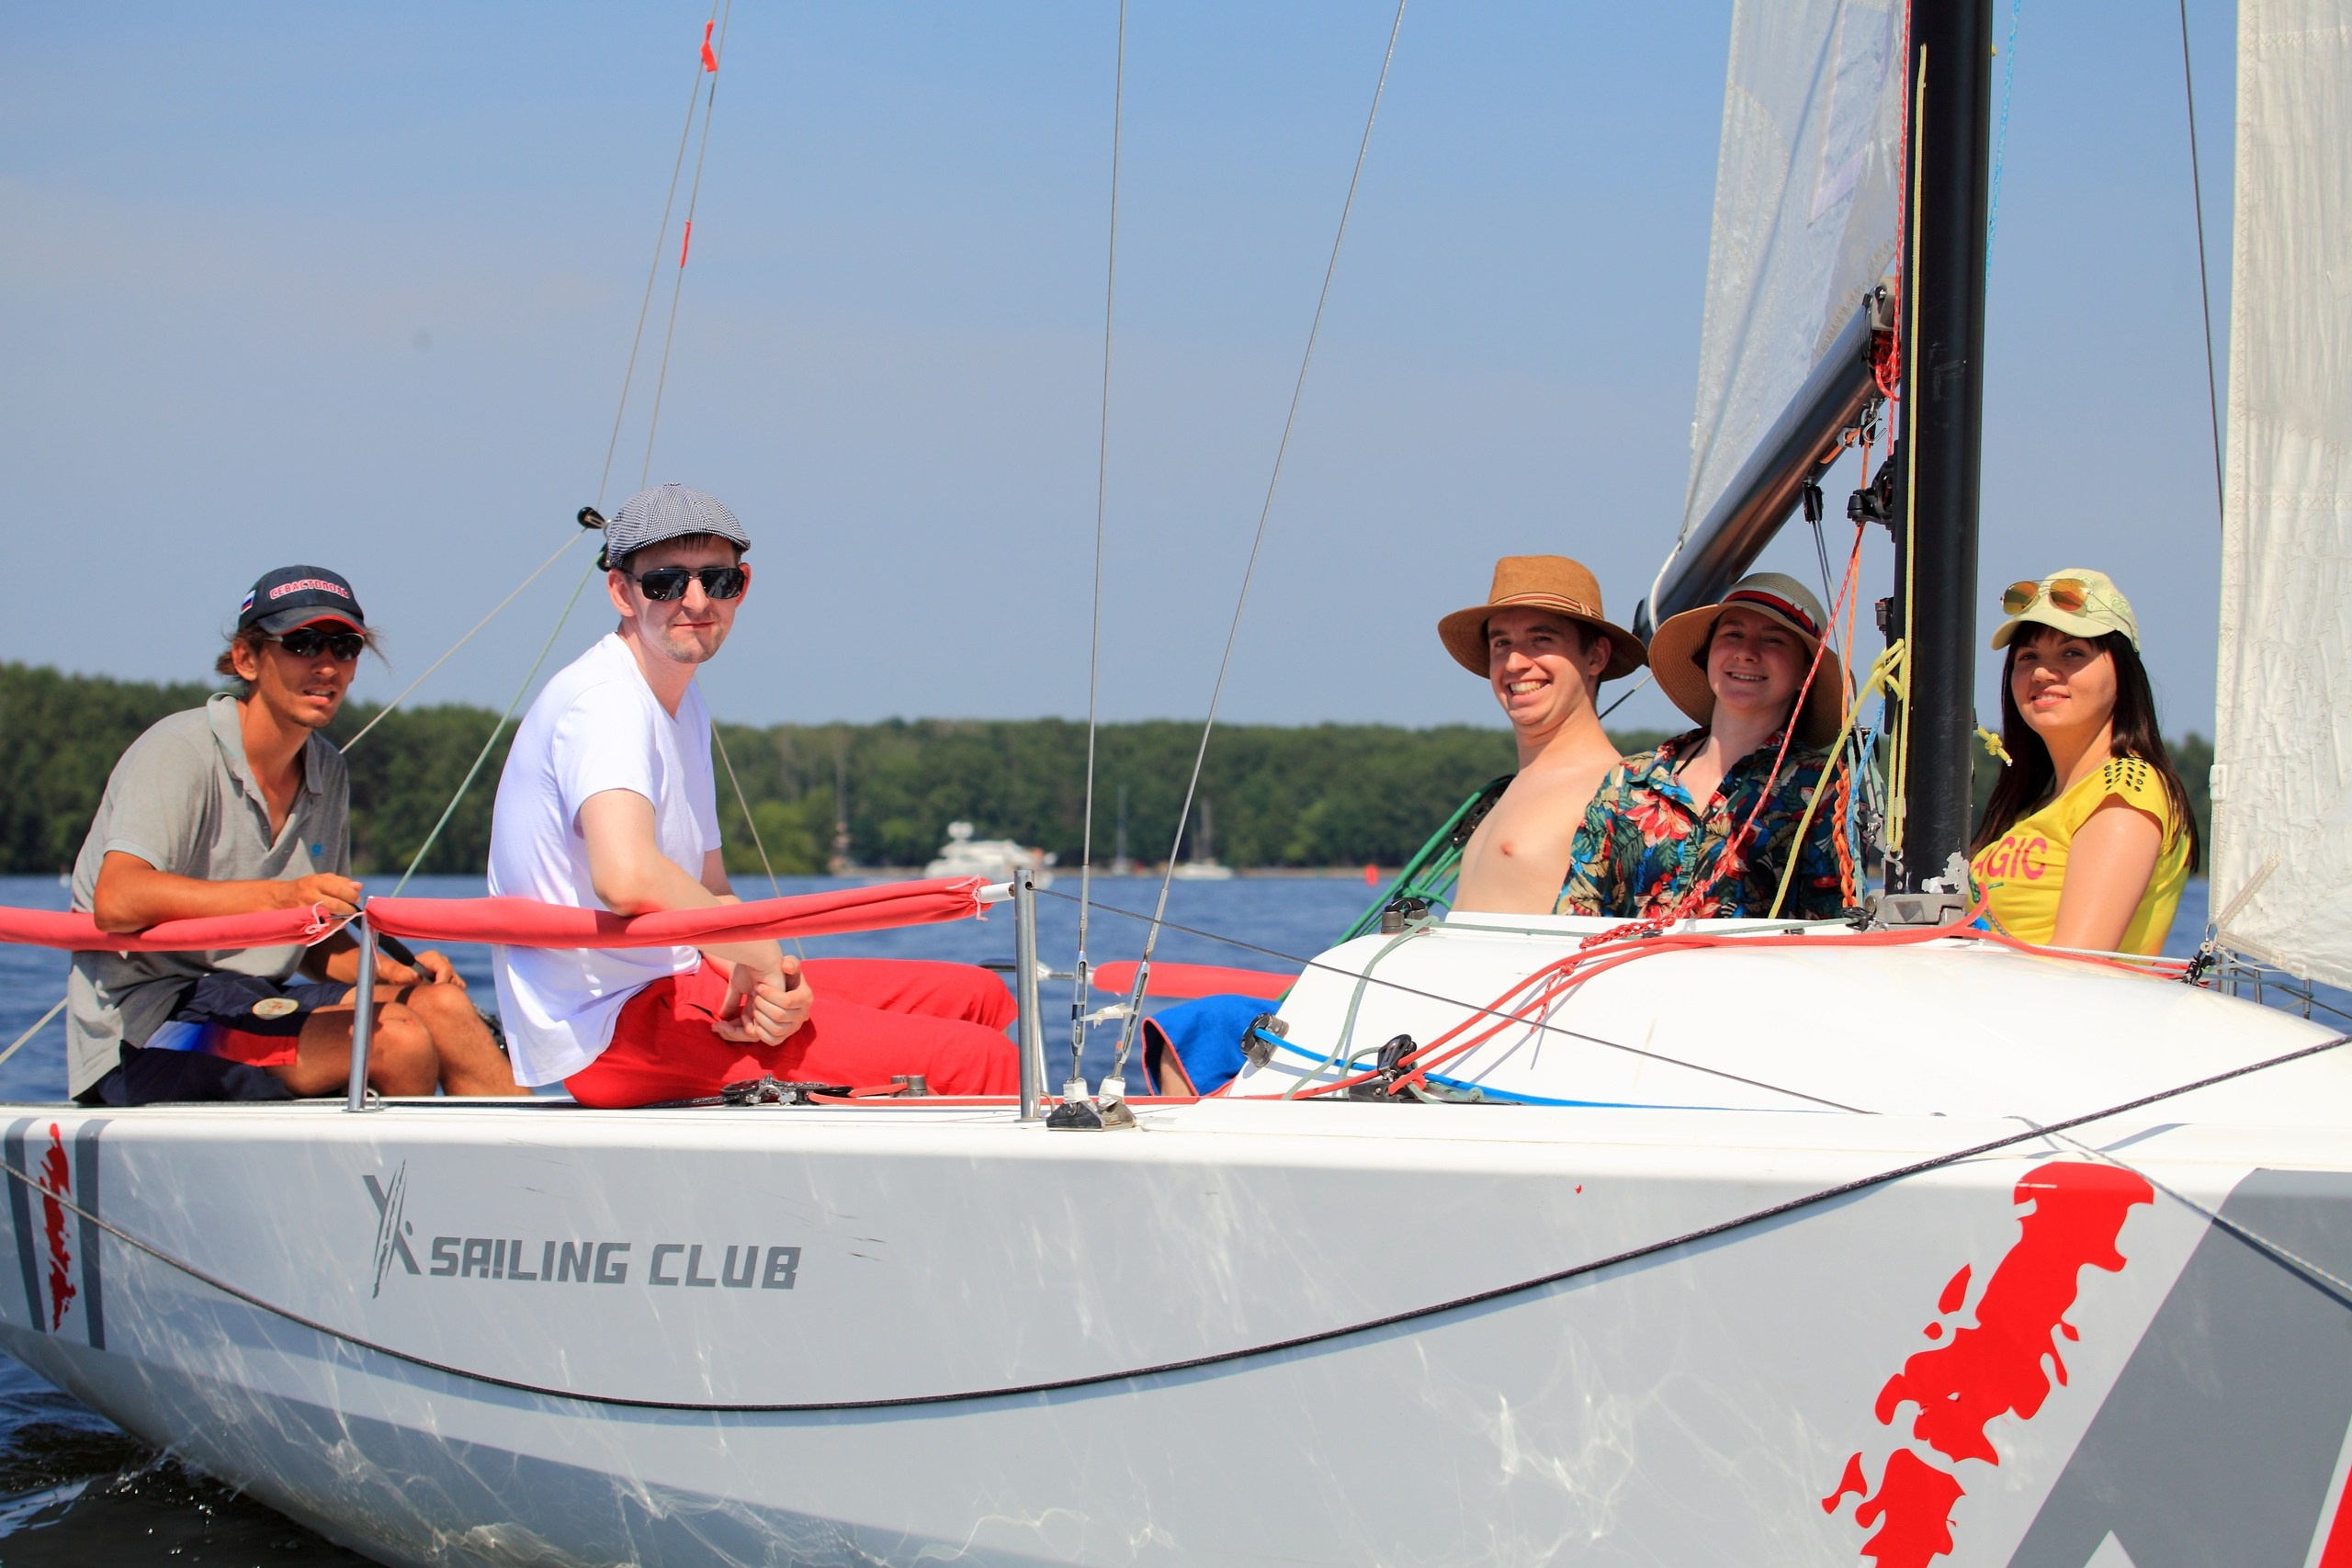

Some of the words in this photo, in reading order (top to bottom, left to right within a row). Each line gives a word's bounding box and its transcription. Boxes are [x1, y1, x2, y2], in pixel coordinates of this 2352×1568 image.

[269, 579, 350, 600] СЕВАСТОПОЛЬ
[1969, 836, 2048, 881] AGIC
[429, 1236, 631, 1284] SAILING
[648, 1243, 802, 1290] CLUB
